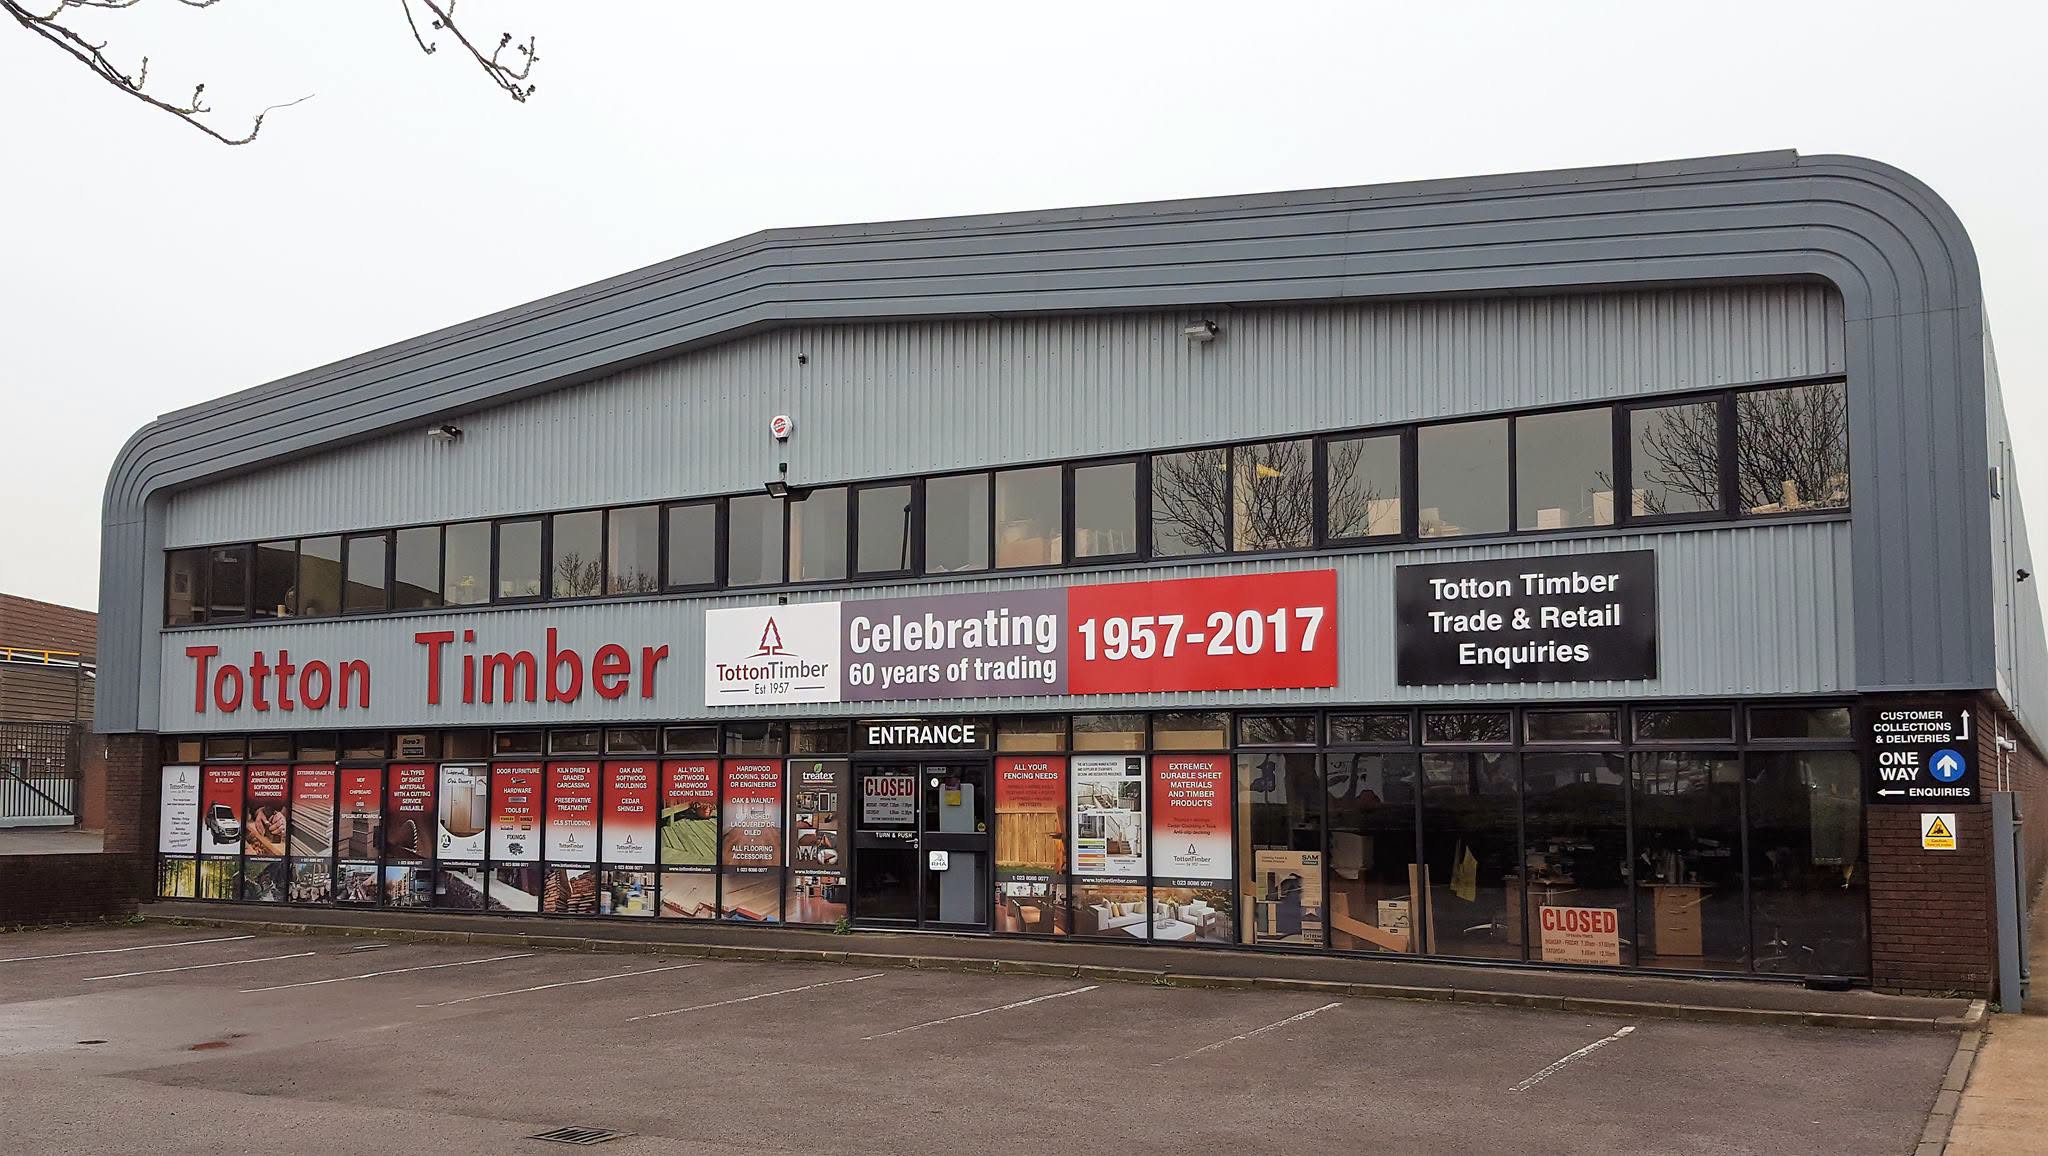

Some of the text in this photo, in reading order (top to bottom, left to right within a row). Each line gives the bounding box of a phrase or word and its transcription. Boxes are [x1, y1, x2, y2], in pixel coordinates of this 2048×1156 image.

[1429, 571, 1619, 600] Totton Timber
[1428, 604, 1621, 633] Trade & Retail
[850, 608, 1057, 654] Celebrating
[1077, 606, 1324, 661] 1957-2017
[1459, 640, 1590, 670] Enquiries
[186, 627, 669, 713] Totton Timber
[716, 660, 828, 682] TottonTimber
[850, 655, 1057, 689] 60 years of trading
[754, 681, 790, 695] Est 1957
[1880, 711, 1943, 721] CUSTOMER
[868, 724, 976, 745] ENTRANCE
[1873, 722, 1952, 732] COLLECTIONS
[1875, 734, 1951, 744] & DELIVERIES
[1879, 752, 1919, 766] ONE
[803, 772, 835, 780] treatex
[1879, 767, 1919, 781] WAY
[865, 778, 913, 796] CLOSED
[1168, 790, 1214, 798] AND TIMBER
[1909, 788, 1970, 797] ENQUIRIES
[1542, 909, 1616, 934] CLOSED
